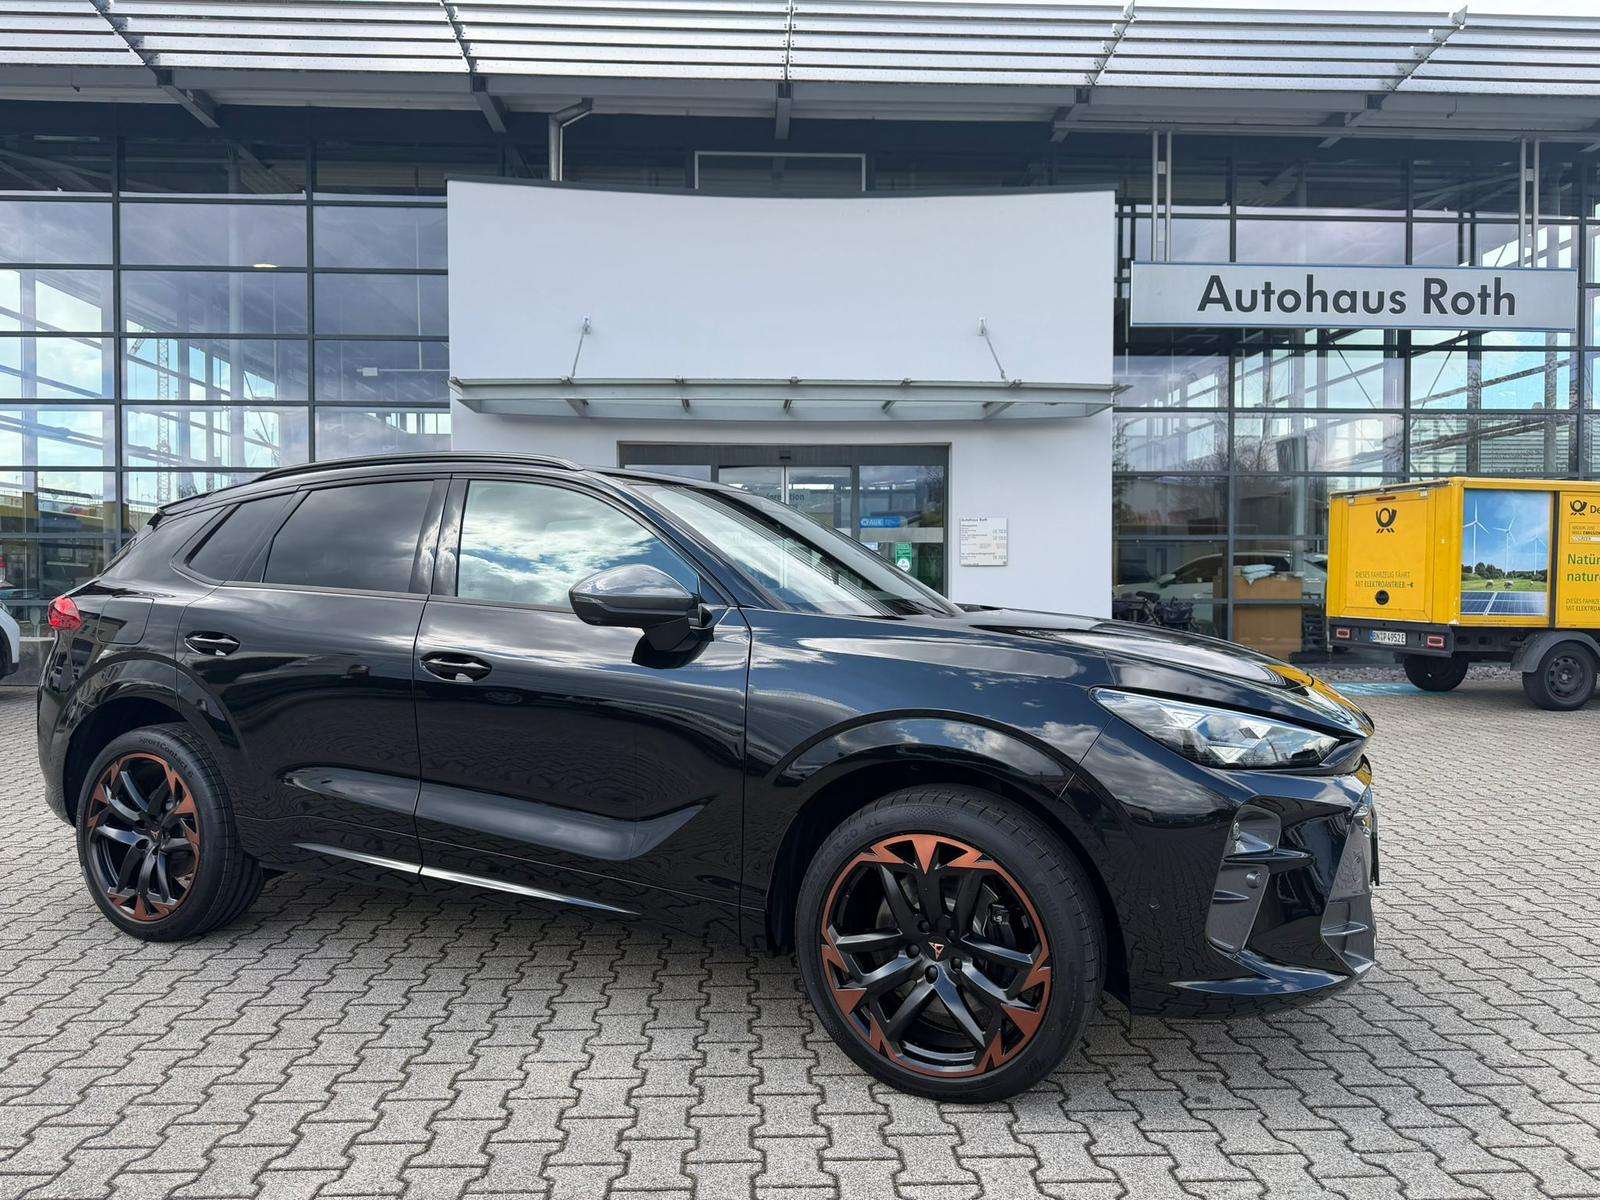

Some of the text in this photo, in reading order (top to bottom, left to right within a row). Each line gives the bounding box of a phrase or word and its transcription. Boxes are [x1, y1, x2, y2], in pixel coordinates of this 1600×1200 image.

[1197, 274, 1516, 315] Autohaus Roth
[1567, 572, 1600, 582] natur
